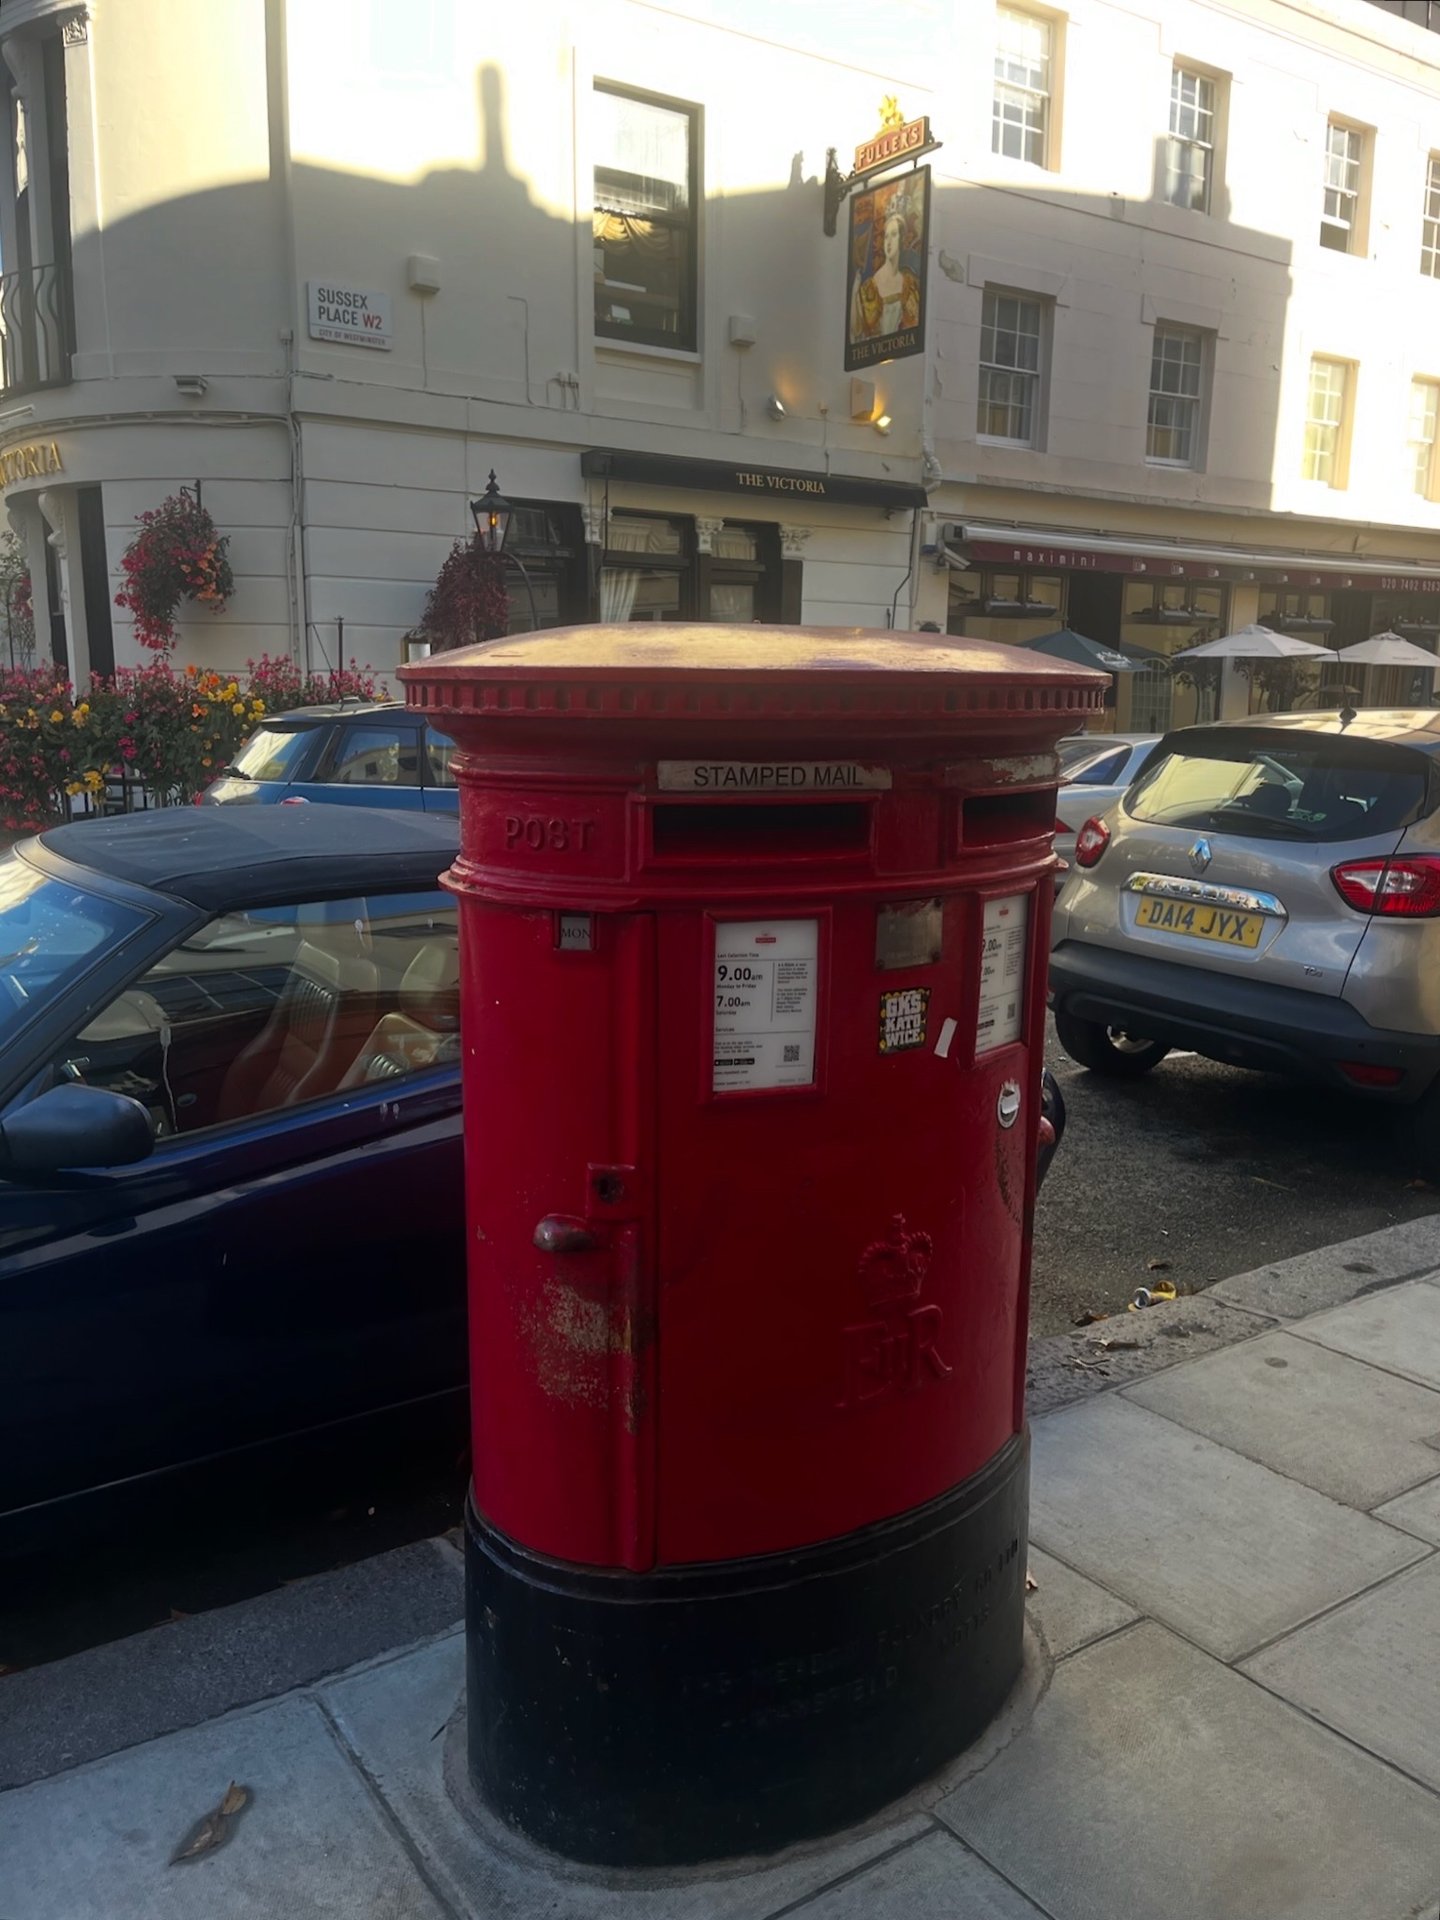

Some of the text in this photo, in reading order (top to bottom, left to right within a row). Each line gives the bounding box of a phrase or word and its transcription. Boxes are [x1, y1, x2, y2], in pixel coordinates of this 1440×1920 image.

[859, 127, 919, 168] FULLER'S
[318, 287, 368, 310] SUSSEX
[318, 305, 383, 330] PLACE W2
[852, 333, 916, 361] THE VICTORIA
[736, 472, 825, 494] THE VICTORIA
[1013, 550, 1096, 567] maximini
[1381, 576, 1397, 590] 020
[694, 766, 864, 787] STAMPED MAIL
[505, 815, 594, 852] POST
[1147, 900, 1248, 942] DA14 JYX
[560, 927, 591, 939] MON
[717, 965, 763, 981] 9.00am
[716, 995, 751, 1007] 7.00am
[885, 993, 922, 1017] GKS
[885, 1028, 921, 1047] WICE
